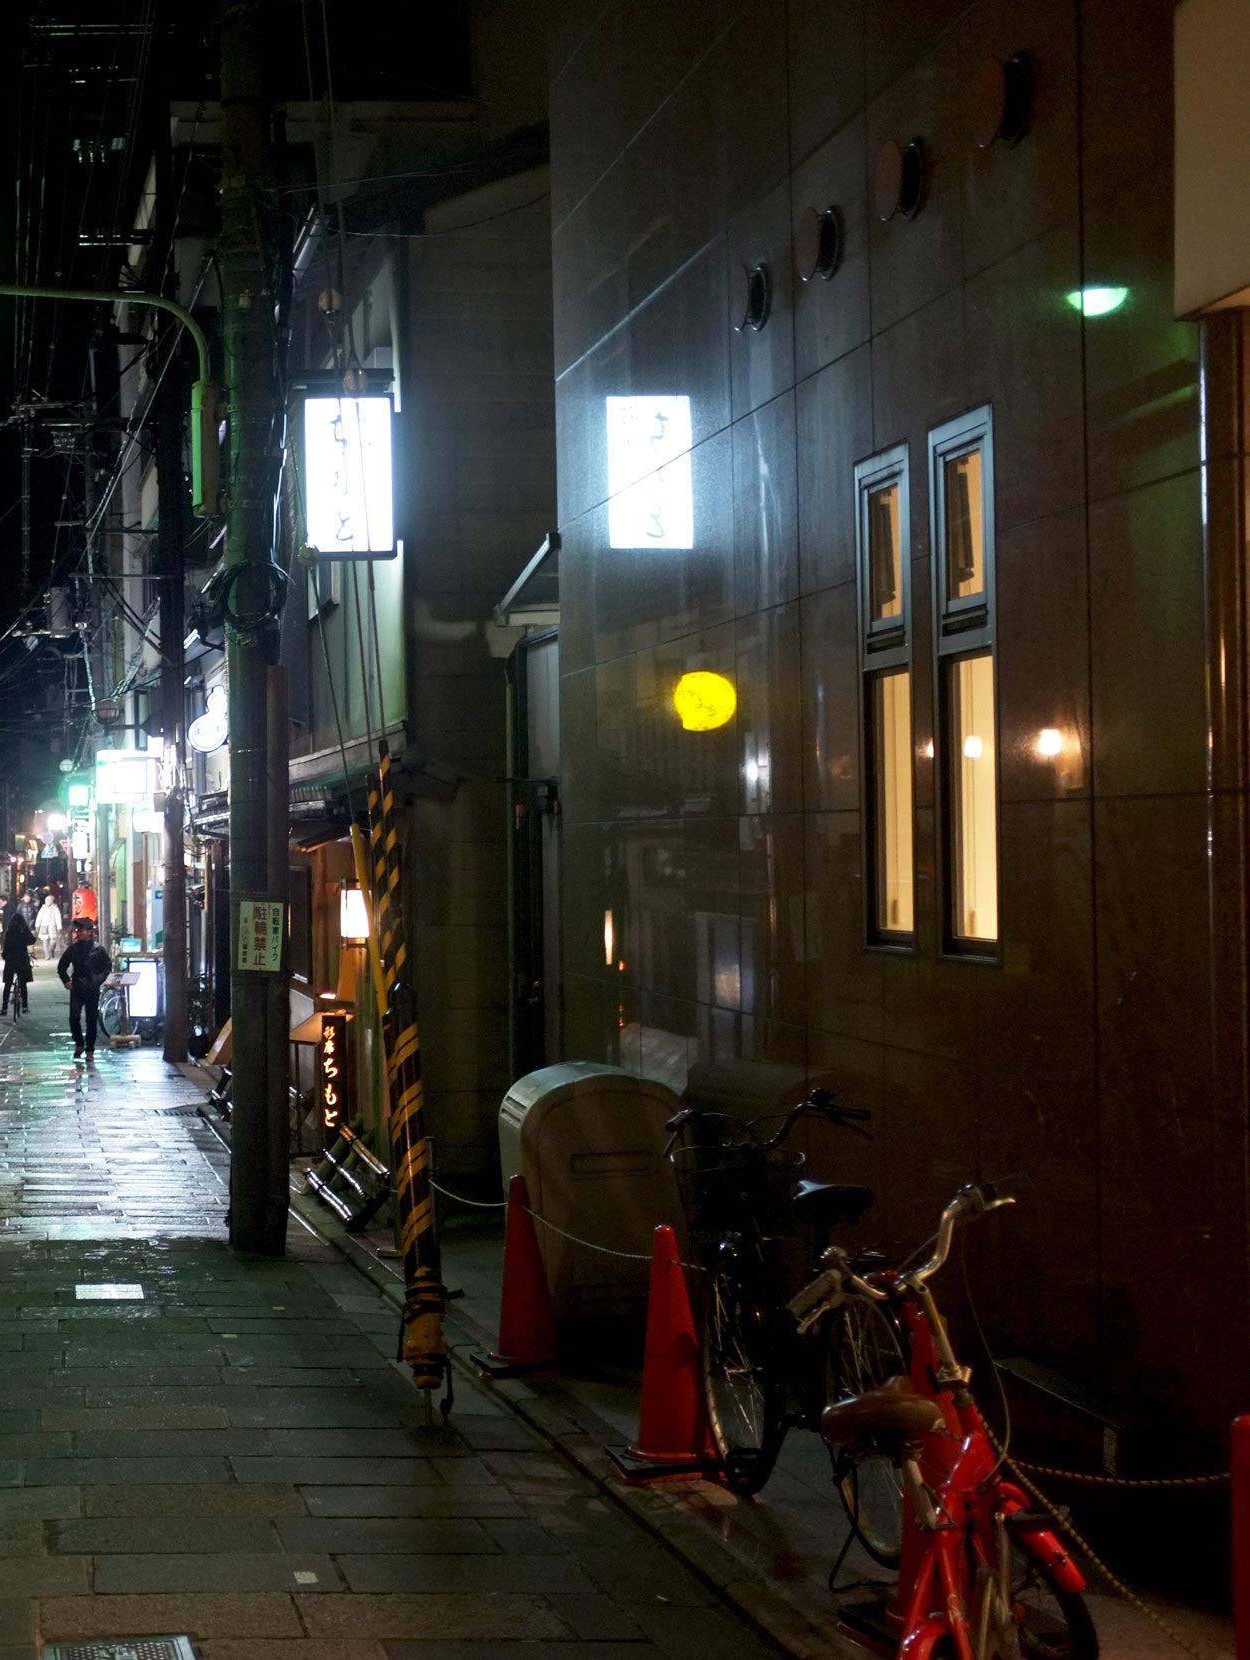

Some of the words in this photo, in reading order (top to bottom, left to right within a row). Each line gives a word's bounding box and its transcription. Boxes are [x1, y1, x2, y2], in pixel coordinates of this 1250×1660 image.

[253, 906, 268, 966] 駐輪禁止
[271, 908, 280, 962] 自転車バイク
